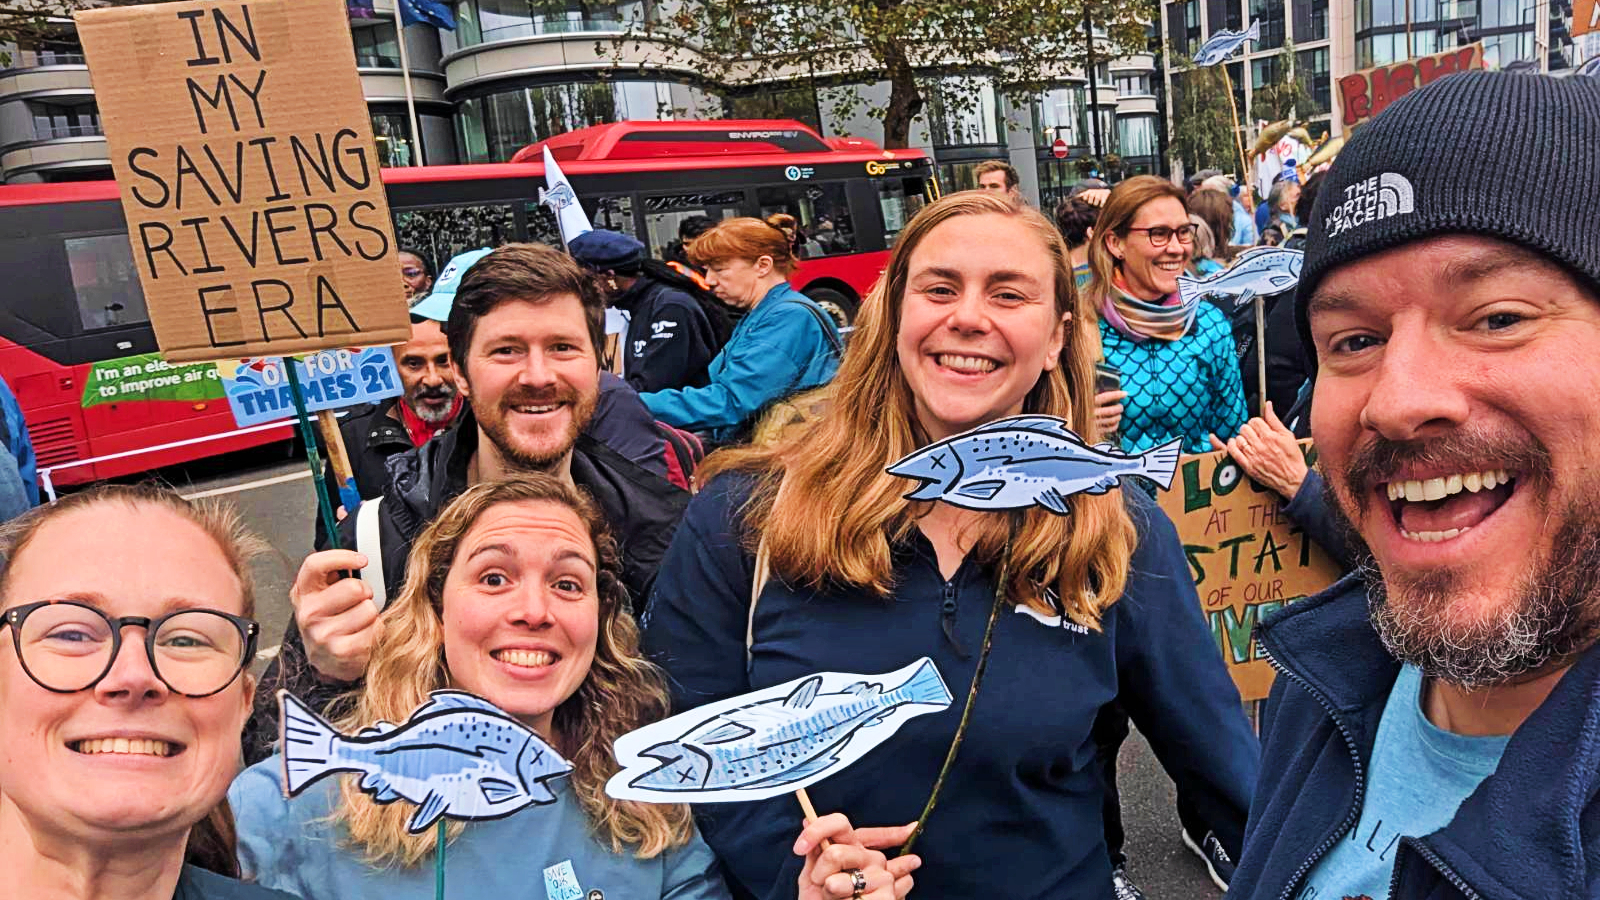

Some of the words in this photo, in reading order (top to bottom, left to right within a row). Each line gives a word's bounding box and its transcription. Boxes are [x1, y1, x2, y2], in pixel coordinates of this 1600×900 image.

[177, 5, 261, 66] IN
[186, 69, 267, 135] MY
[127, 128, 371, 210] SAVING
[865, 160, 886, 175] Go
[1344, 176, 1378, 199] THE
[1325, 191, 1378, 229] NORTH
[1329, 205, 1376, 238] FACE
[138, 200, 389, 280] RIVERS
[197, 275, 362, 348] ERA
[95, 368, 120, 382] I'm
[123, 364, 142, 376] an
[304, 349, 354, 378] FOR
[99, 385, 117, 397] to
[120, 374, 181, 393] improve
[183, 369, 203, 382] air
[237, 373, 358, 416] THAMES
[360, 364, 396, 394] 21
[1204, 508, 1232, 536] AT
[1248, 504, 1289, 527] THE
[1183, 529, 1312, 585] STAT
[1208, 586, 1232, 606] OF
[1244, 579, 1284, 602] OUR
[1063, 620, 1089, 635] trust
